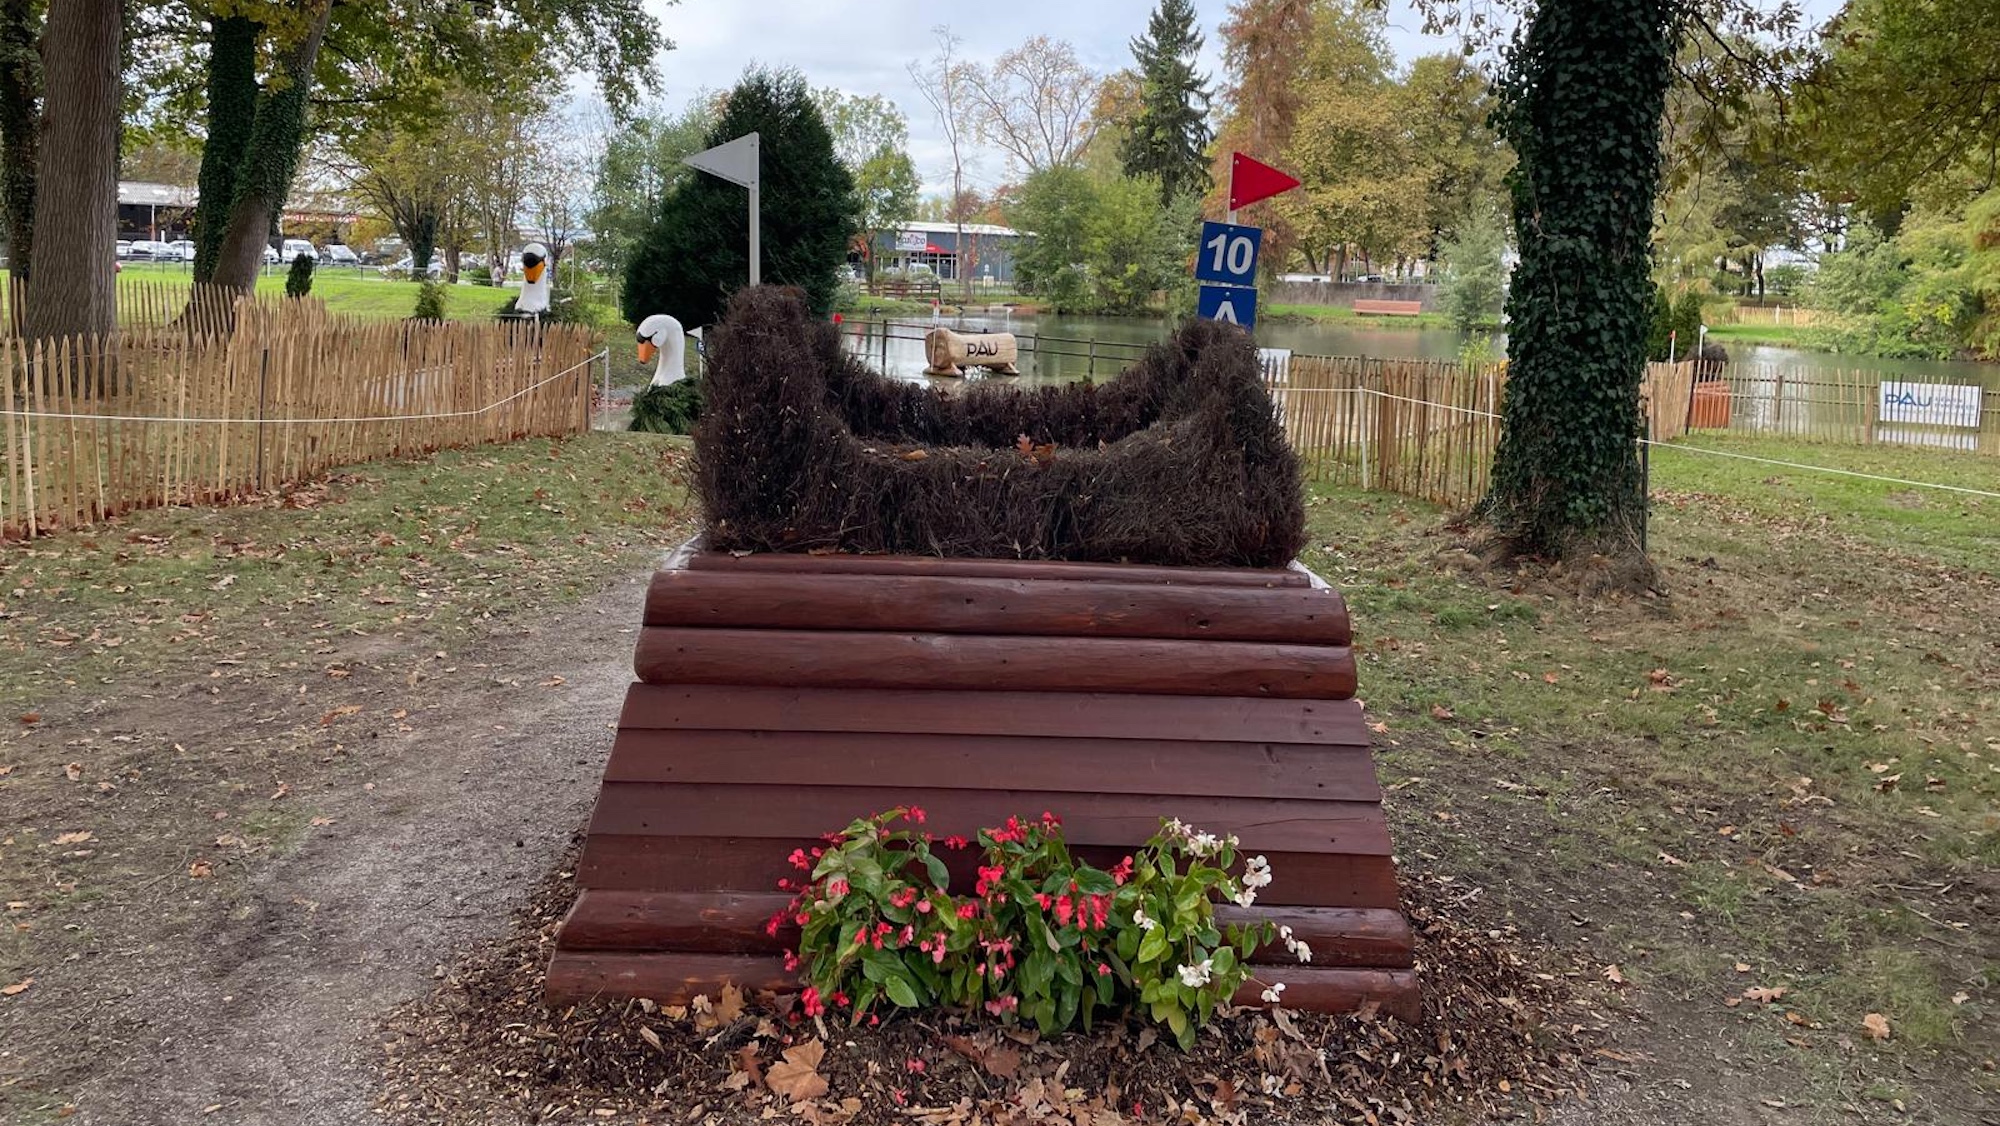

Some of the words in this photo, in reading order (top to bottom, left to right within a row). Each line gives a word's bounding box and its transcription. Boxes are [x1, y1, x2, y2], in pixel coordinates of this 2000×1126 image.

[1207, 233, 1254, 275] 10
[966, 340, 999, 357] PAU
[1885, 392, 1932, 407] PAU
